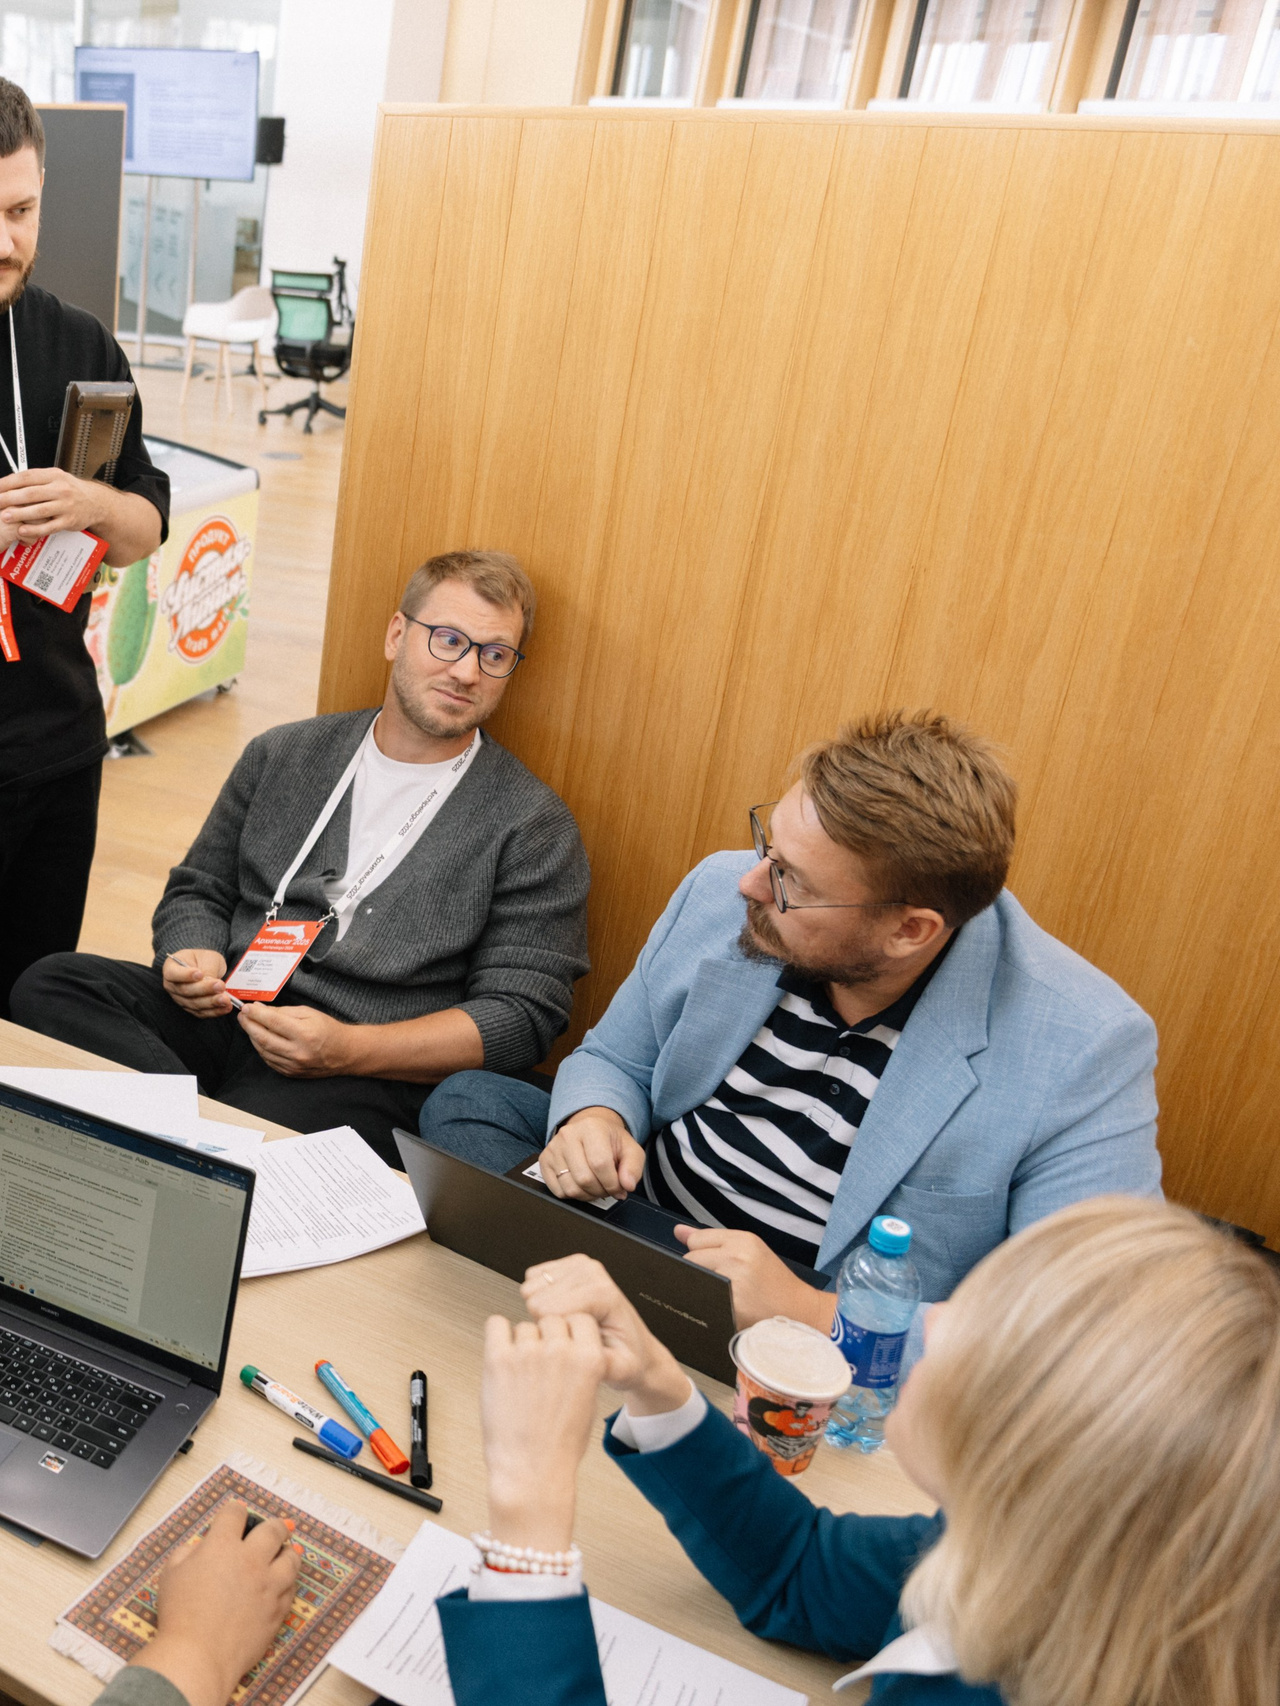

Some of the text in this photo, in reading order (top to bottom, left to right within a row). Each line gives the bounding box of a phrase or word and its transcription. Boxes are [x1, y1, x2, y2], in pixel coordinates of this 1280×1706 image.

[409, 789, 438, 822] Archipelago
[359, 854, 385, 886] Архипелаг
[255, 937, 293, 946] Архипелаг
